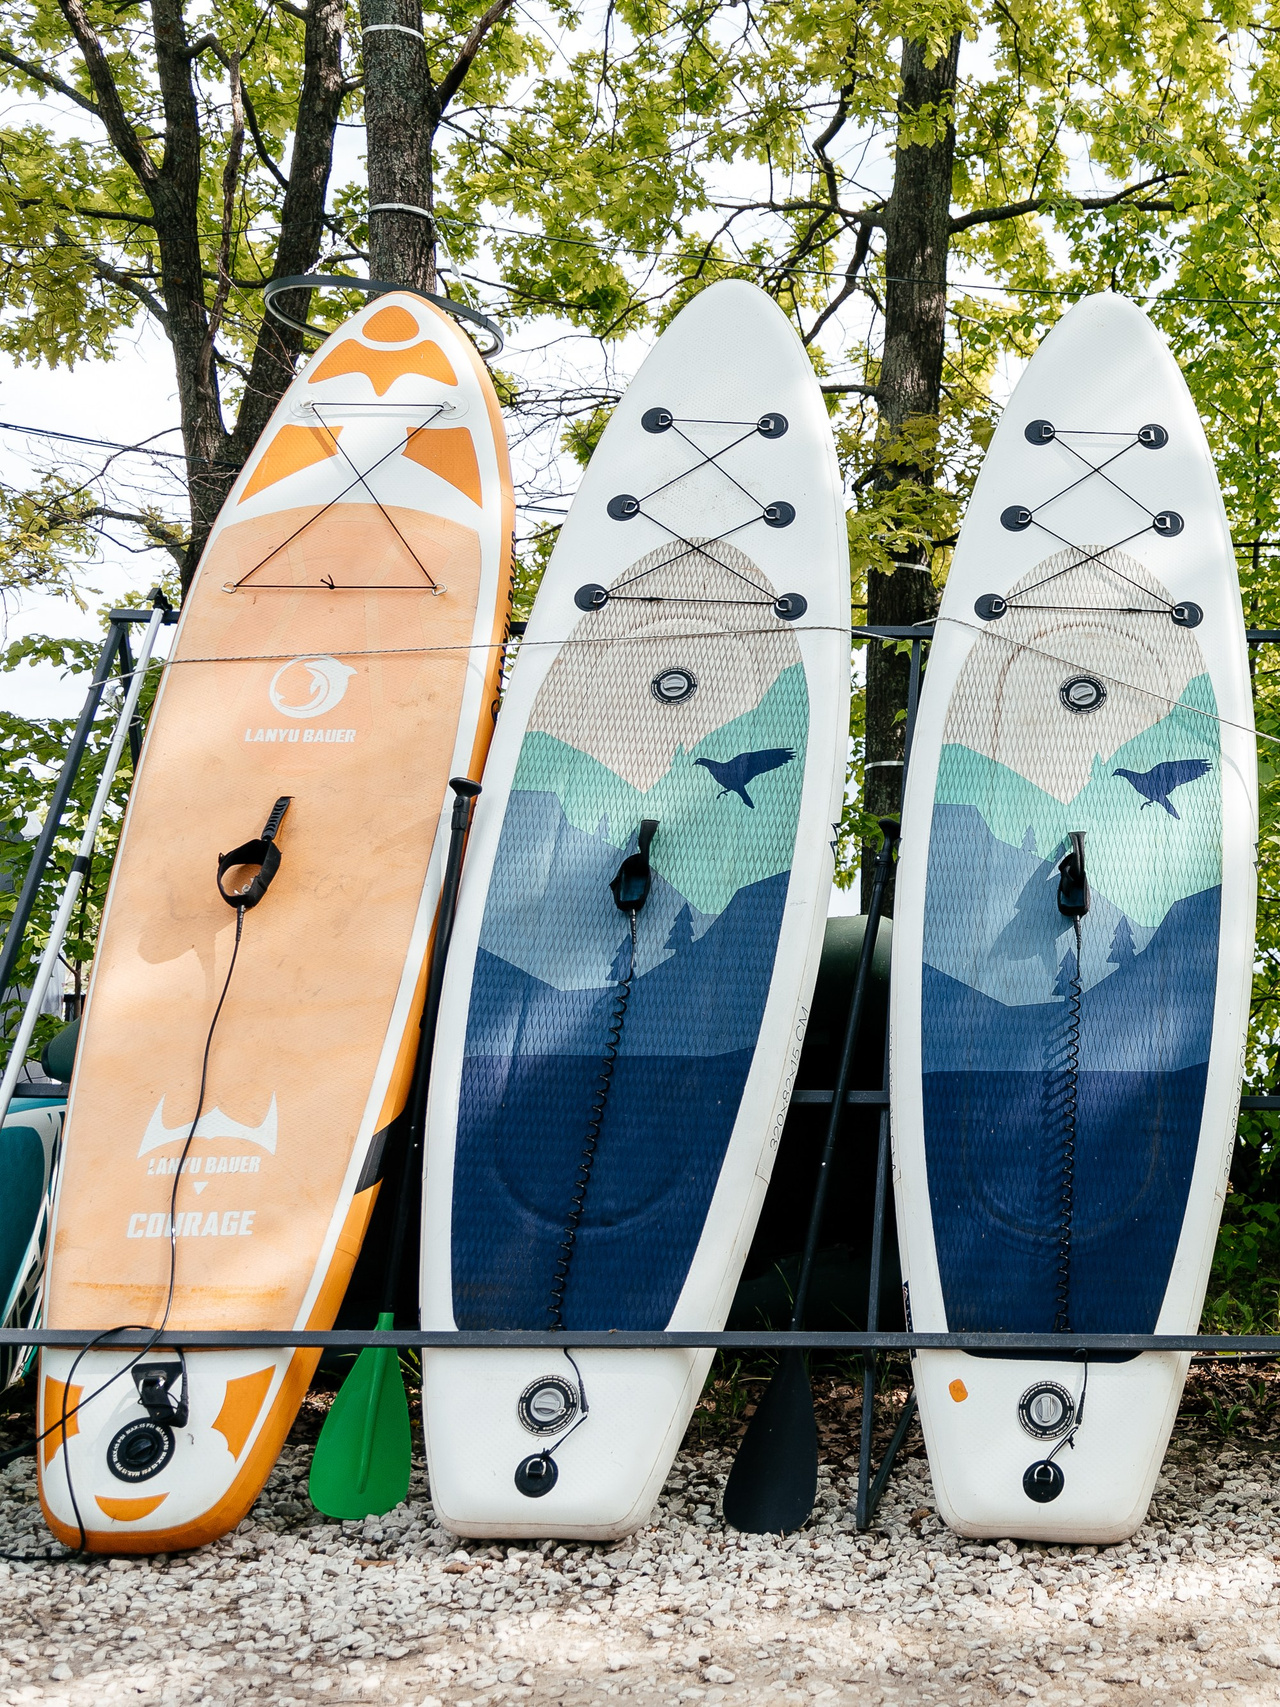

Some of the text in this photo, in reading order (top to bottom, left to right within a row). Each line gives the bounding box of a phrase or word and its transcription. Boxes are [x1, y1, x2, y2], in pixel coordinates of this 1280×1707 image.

[244, 728, 357, 743] LANYU BAUER
[769, 1006, 809, 1152] 320x82x15 CM
[147, 1156, 262, 1175] LANYU BAUER
[126, 1210, 257, 1239] COURAGE
